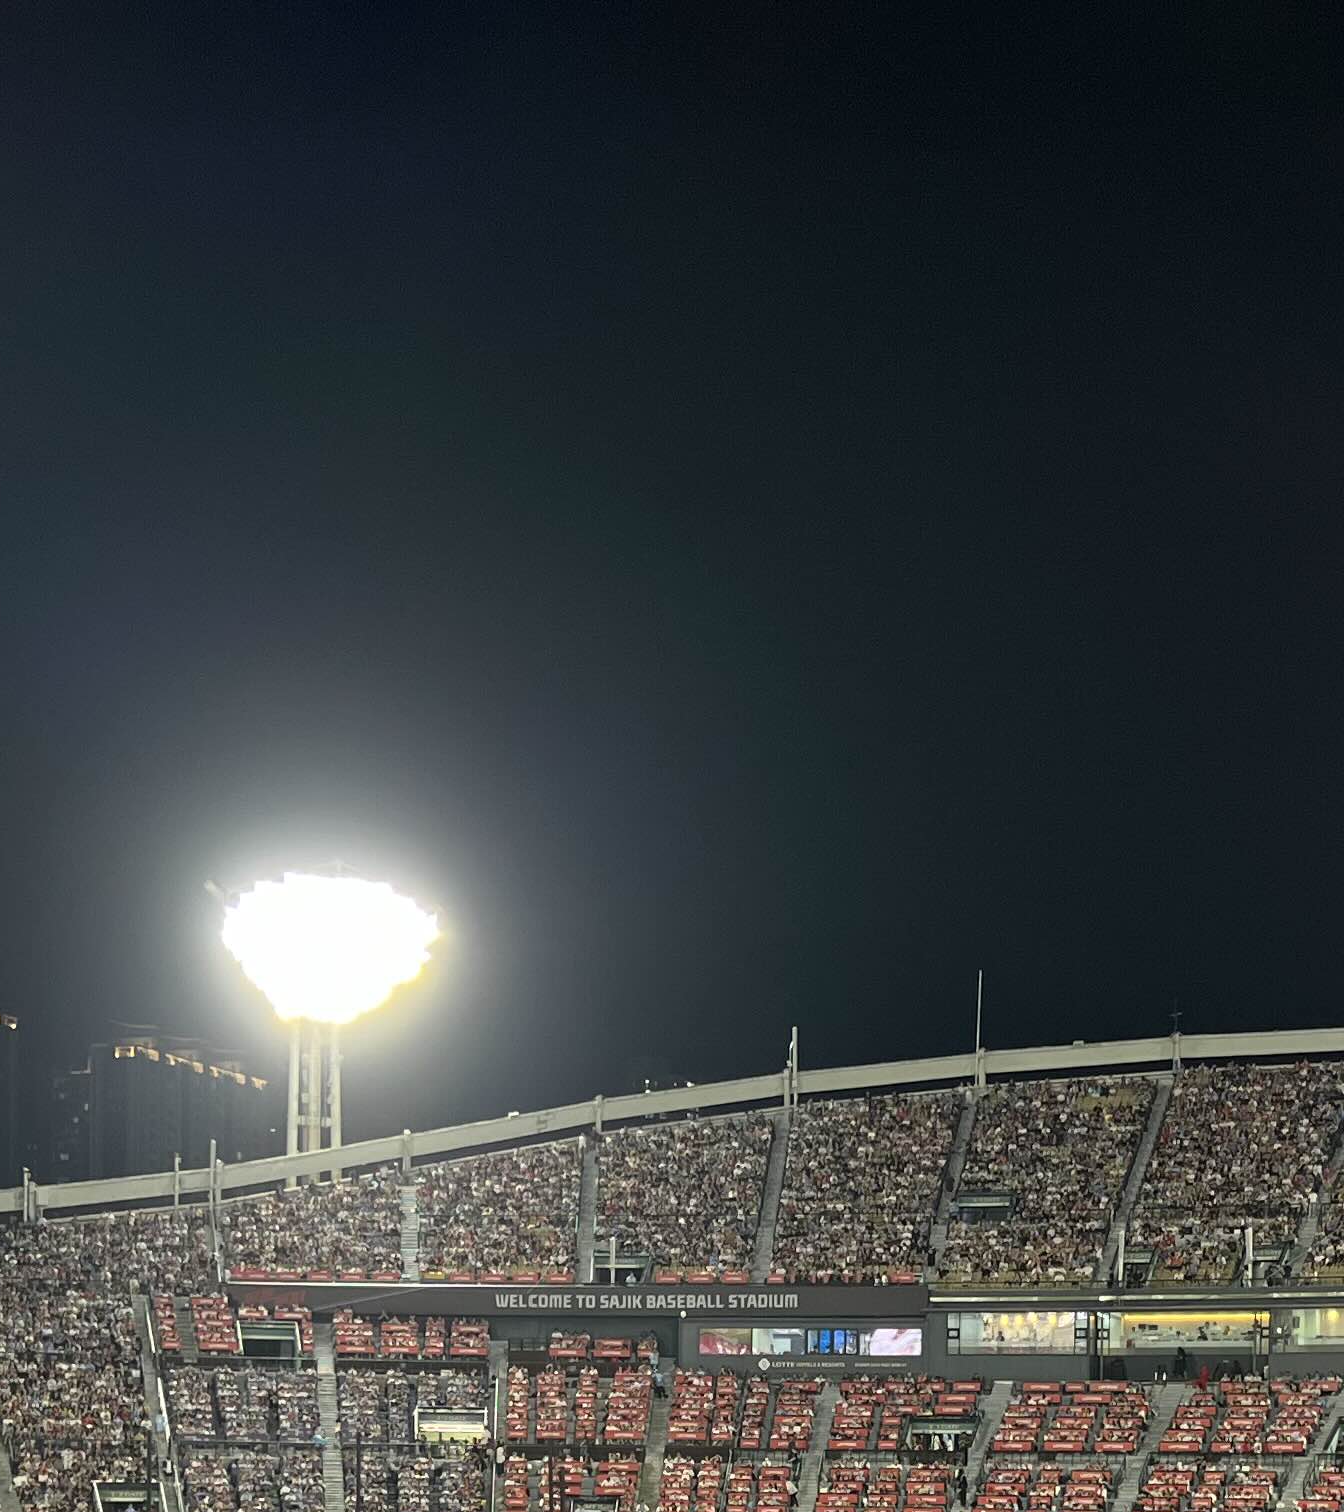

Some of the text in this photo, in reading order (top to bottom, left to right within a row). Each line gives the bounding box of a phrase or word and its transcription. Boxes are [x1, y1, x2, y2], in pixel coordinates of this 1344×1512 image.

[495, 1293, 799, 1309] WELCOME TO SAJIK BASEBALL STADIUM
